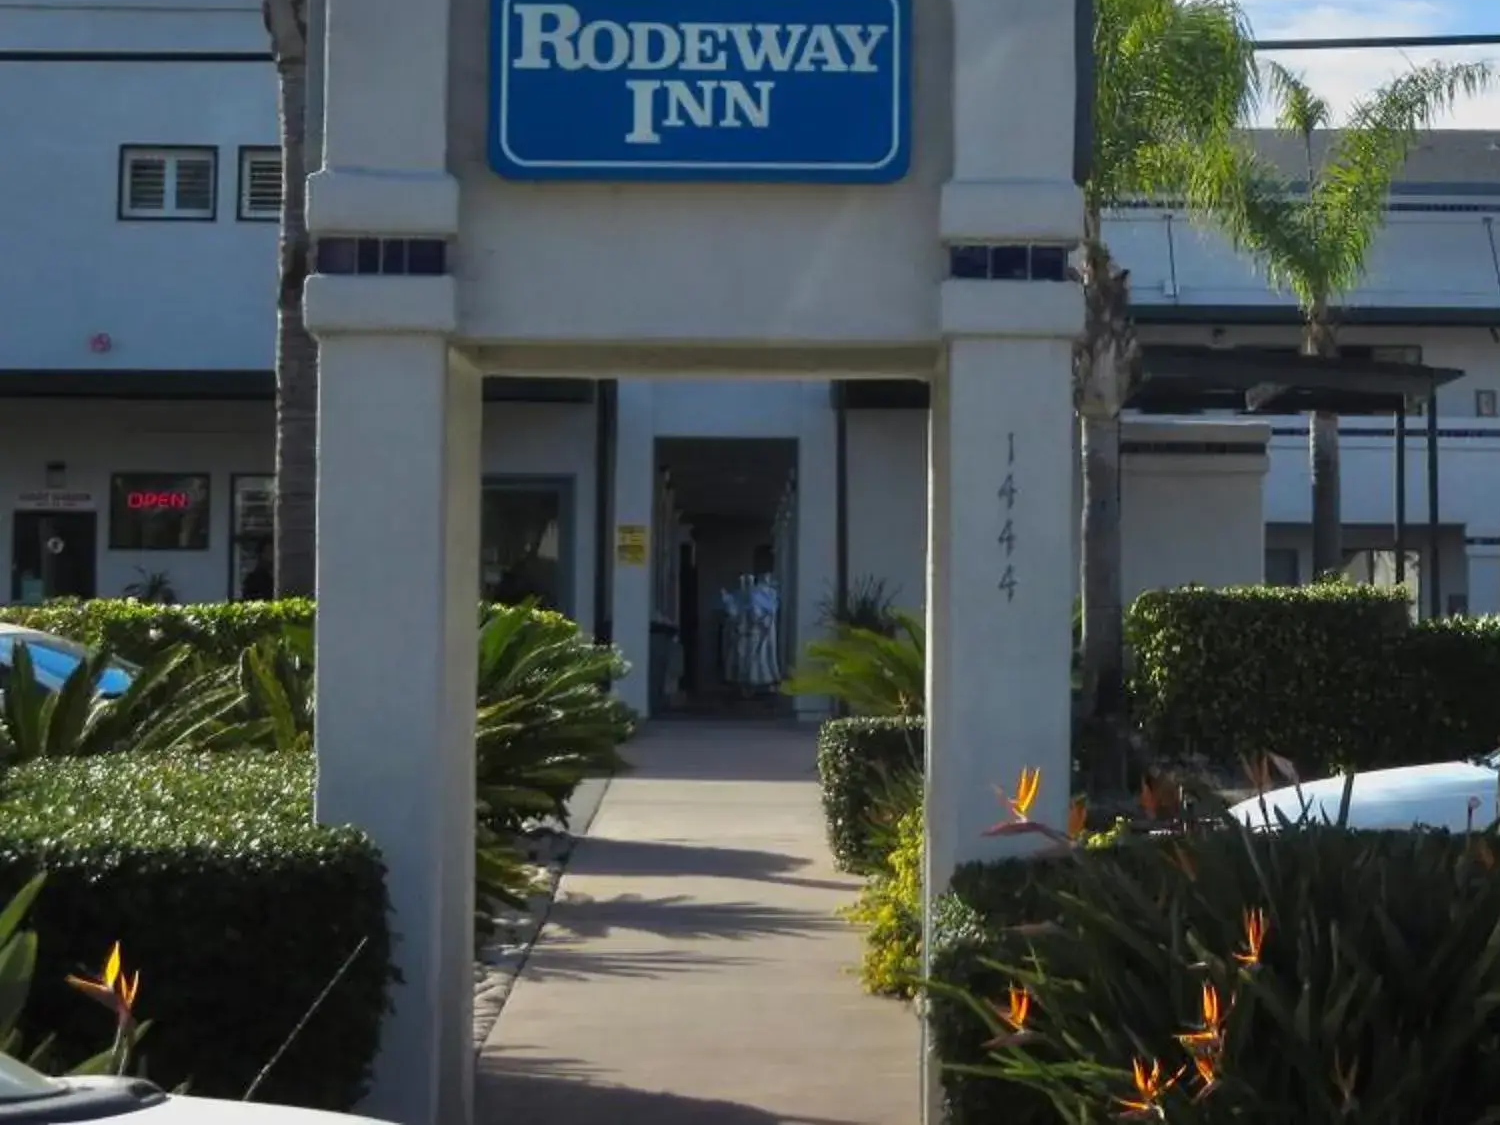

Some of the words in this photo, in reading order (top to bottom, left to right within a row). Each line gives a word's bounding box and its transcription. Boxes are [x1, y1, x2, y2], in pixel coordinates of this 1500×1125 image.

[512, 3, 888, 72] RODEWAY
[625, 79, 775, 144] INN
[127, 491, 188, 509] OPEN
[998, 431, 1018, 602] 1444
